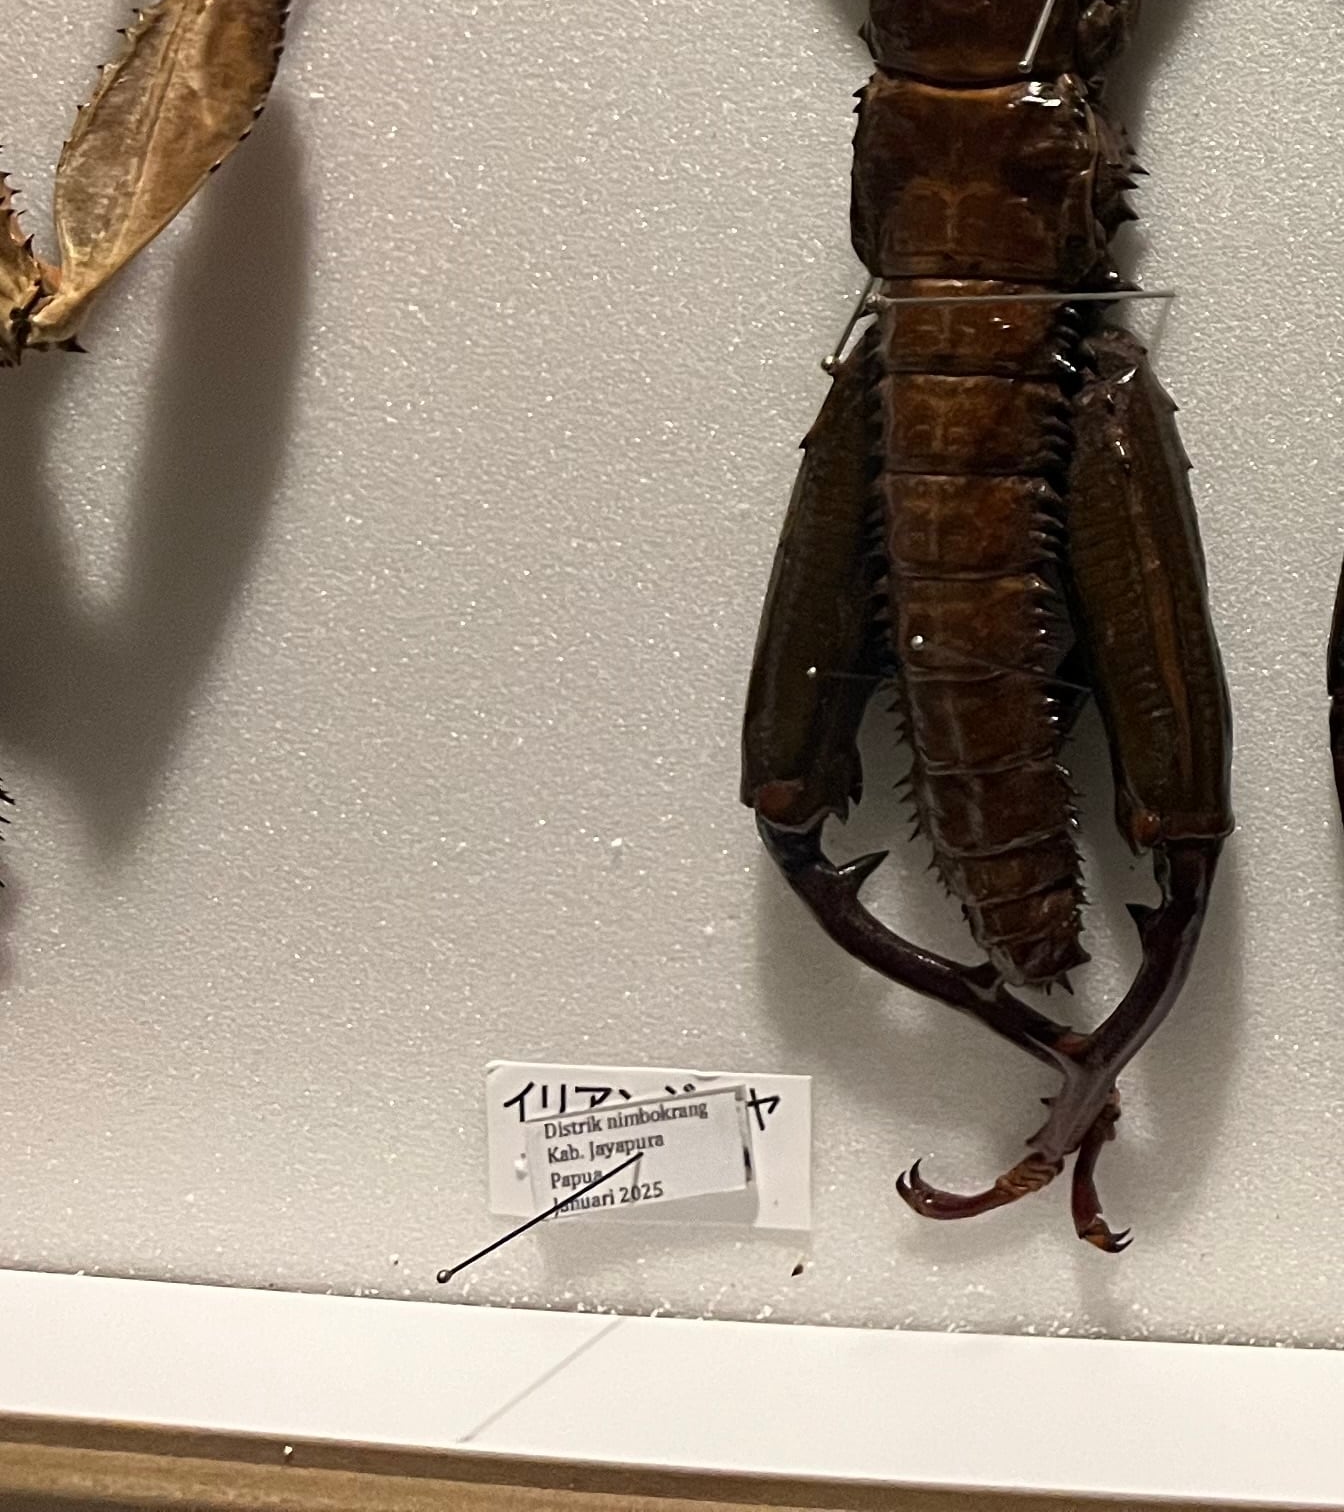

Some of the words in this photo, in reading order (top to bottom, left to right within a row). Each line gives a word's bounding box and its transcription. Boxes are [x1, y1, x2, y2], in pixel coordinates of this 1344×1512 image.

[544, 1116, 603, 1140] Distrik
[607, 1103, 708, 1130] nimbokrang
[547, 1144, 585, 1164] Kab.
[589, 1134, 665, 1161] Jayapura
[551, 1169, 604, 1190] Papua
[619, 1181, 664, 1204] 2025
